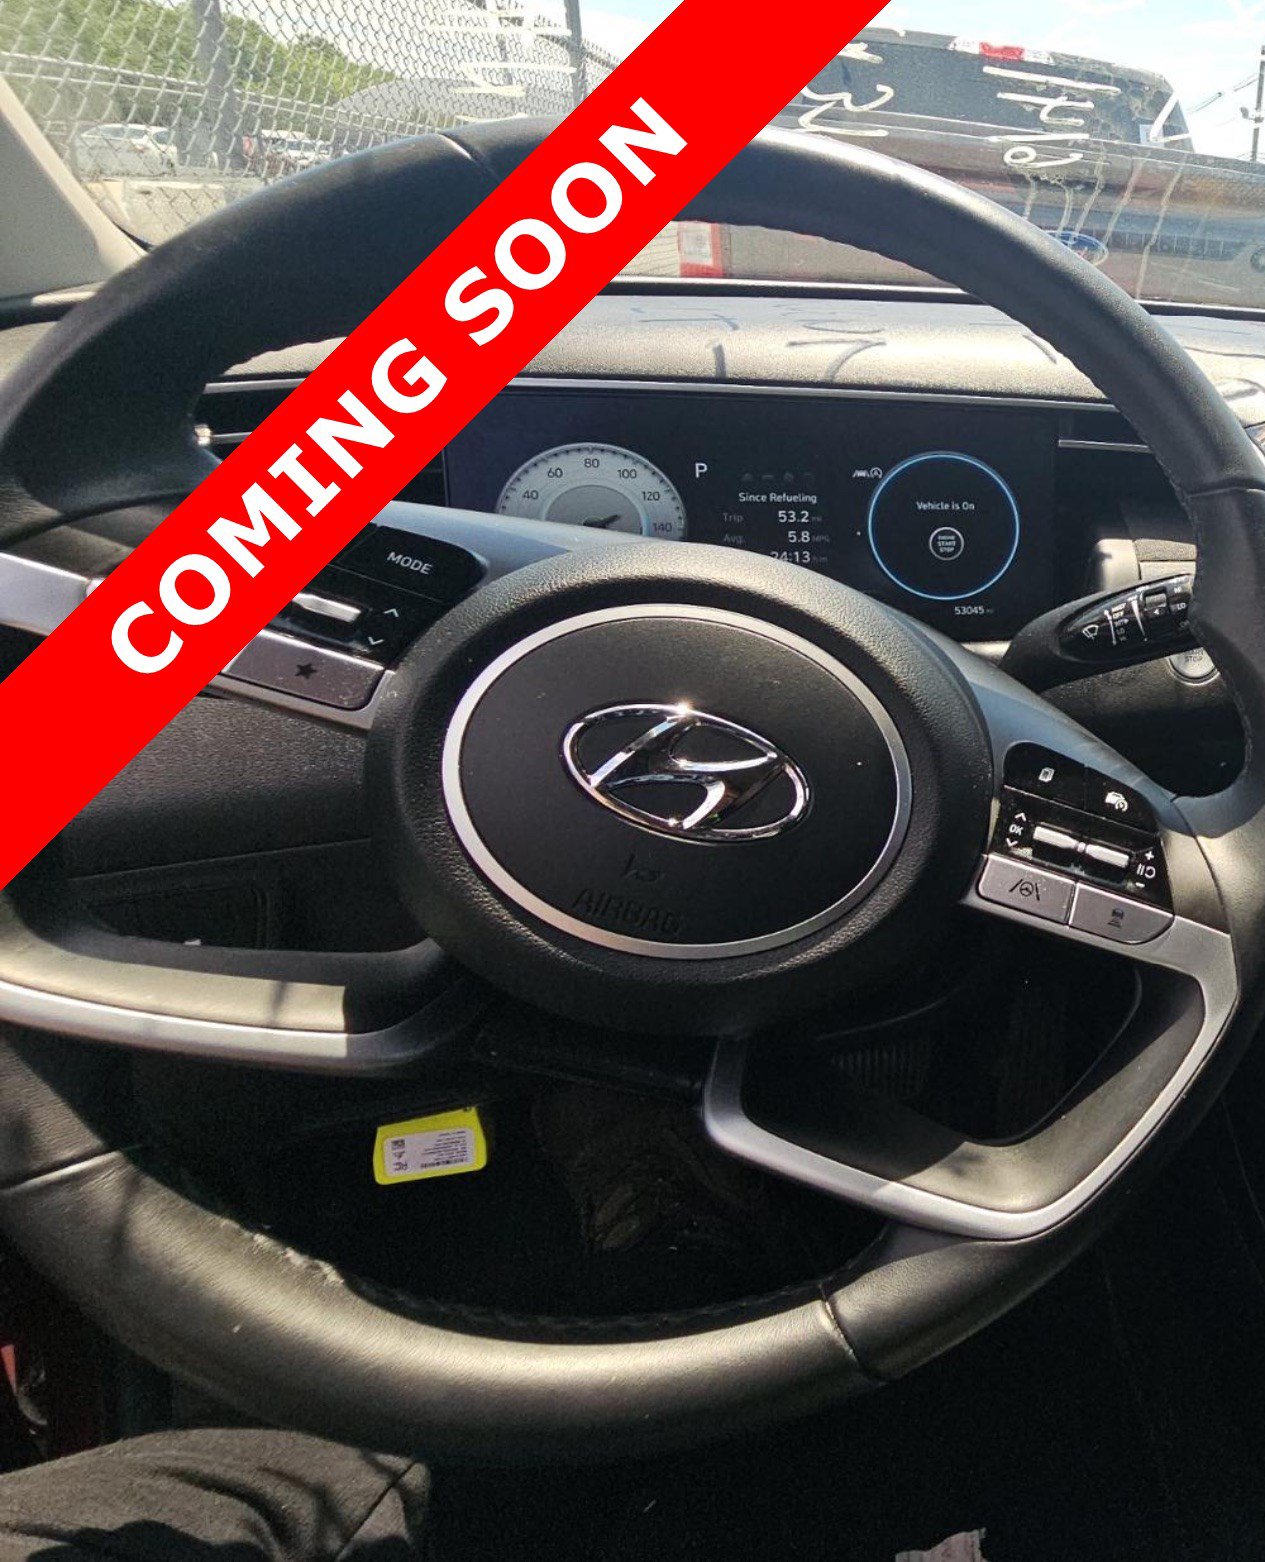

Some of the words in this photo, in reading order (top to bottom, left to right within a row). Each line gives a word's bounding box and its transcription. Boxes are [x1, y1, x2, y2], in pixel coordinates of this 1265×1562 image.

[583, 458, 600, 468] 80
[547, 467, 563, 478] 60
[617, 468, 637, 479] 100
[694, 463, 708, 478] P
[522, 490, 539, 500] 40
[642, 491, 660, 501] 120
[738, 492, 767, 502] Since
[769, 492, 818, 504] Refueling
[915, 501, 950, 511] Vehicle
[951, 501, 960, 511] is
[962, 501, 976, 511] On
[722, 513, 744, 523] Trip
[778, 510, 810, 523] 53.2
[653, 522, 673, 533] 140
[787, 530, 811, 543] 5.8
[386, 551, 434, 576] MODE
[954, 606, 985, 616] 53045
[1009, 823, 1024, 836] OK
